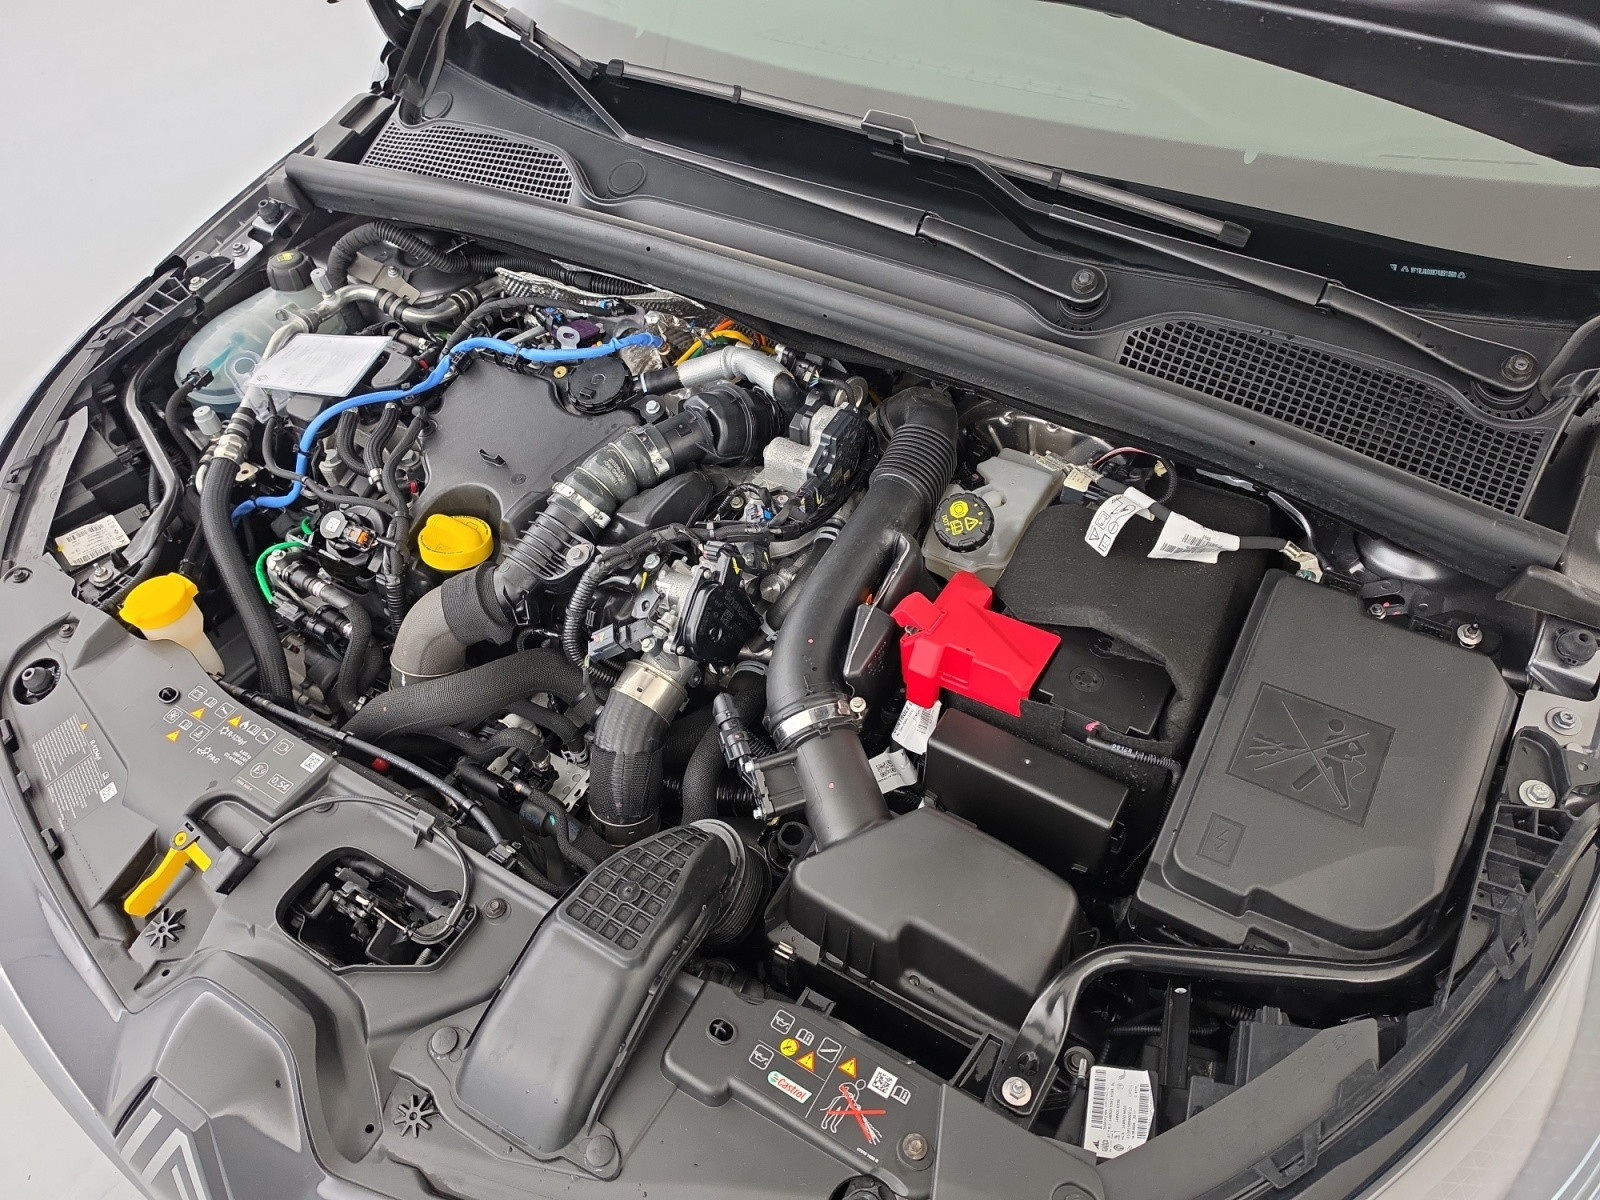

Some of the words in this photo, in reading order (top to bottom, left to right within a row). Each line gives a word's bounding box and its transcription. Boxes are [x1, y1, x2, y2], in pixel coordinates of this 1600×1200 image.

[941, 515, 950, 526] DOT
[206, 753, 221, 764] PAG
[777, 1078, 807, 1100] Castrol
